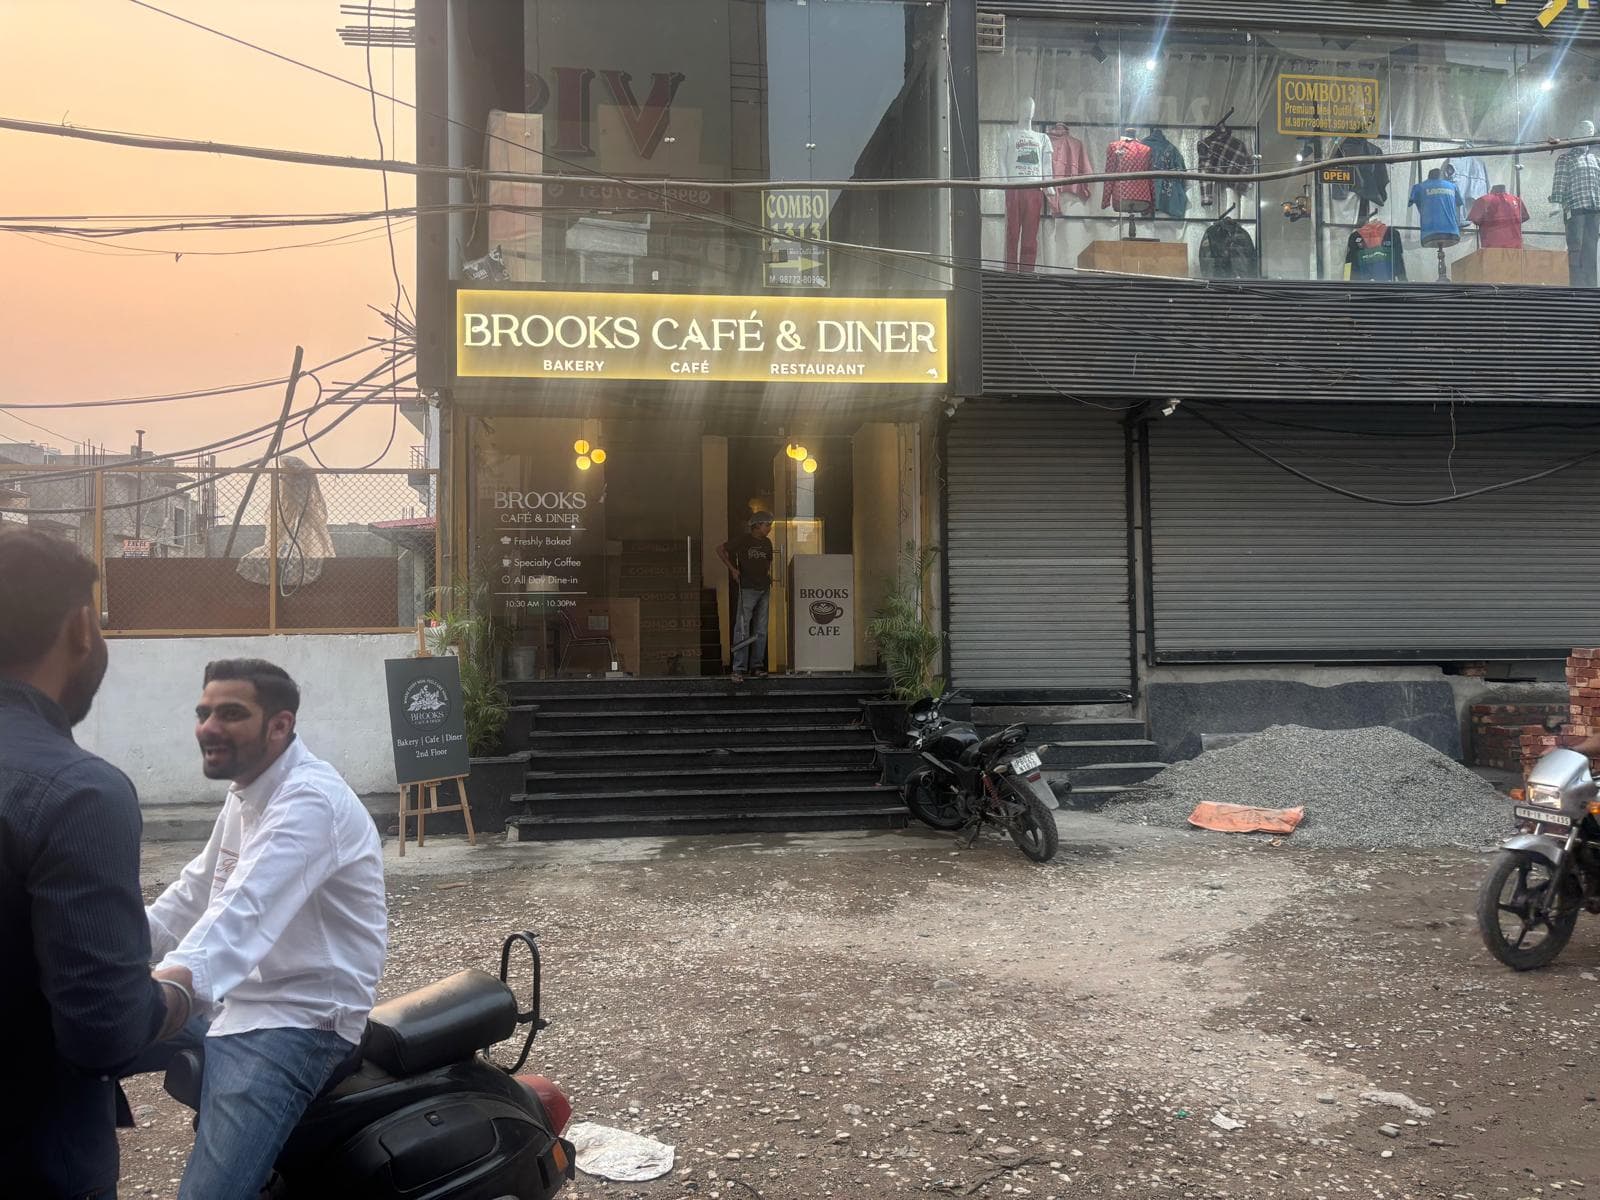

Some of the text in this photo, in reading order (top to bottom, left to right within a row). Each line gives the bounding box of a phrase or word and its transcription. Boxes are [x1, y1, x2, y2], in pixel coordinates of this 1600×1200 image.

[1323, 171, 1351, 181] OPEN
[766, 194, 825, 219] COMBO
[463, 309, 937, 353] BROOKS CAFÉ & DINER
[543, 359, 866, 375] BAKERY CAFÉ RESTAURANT
[494, 491, 587, 509] BROOKS
[500, 511, 580, 523] CAFÉ & DINER
[514, 536, 572, 547] Freshly Baked
[514, 557, 581, 568] Specialty Coffee
[513, 575, 578, 586] All Day Dine-in
[799, 588, 849, 599] BROOKS
[808, 626, 841, 636] CAFE
[411, 711, 444, 720] BROOKS
[397, 737, 419, 748] Bakery
[425, 735, 440, 744] Cafe
[446, 733, 463, 742] Diner
[416, 748, 447, 758] 2nd Floor
